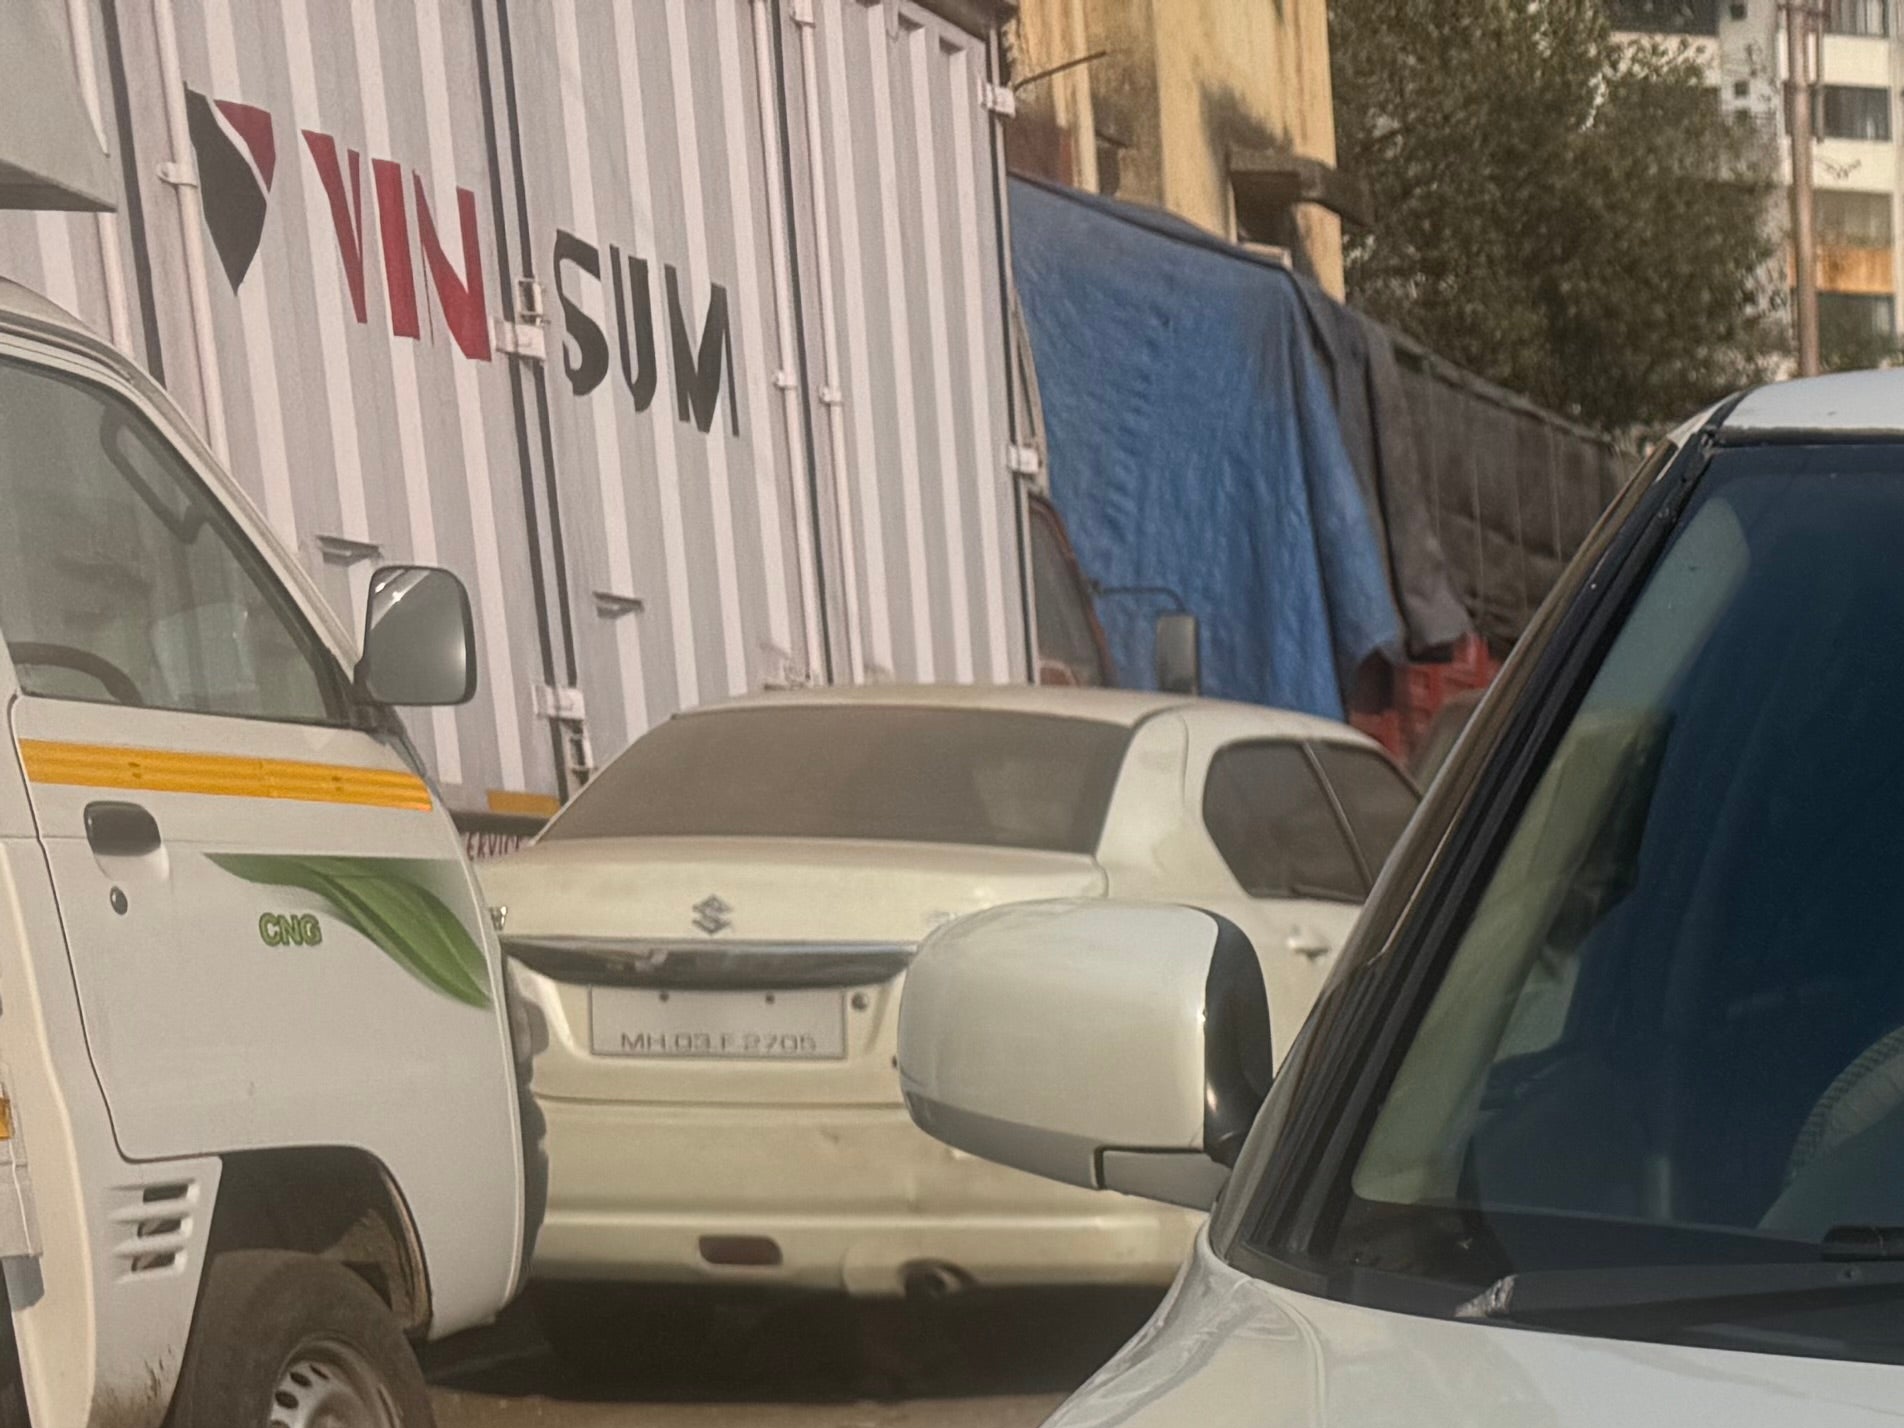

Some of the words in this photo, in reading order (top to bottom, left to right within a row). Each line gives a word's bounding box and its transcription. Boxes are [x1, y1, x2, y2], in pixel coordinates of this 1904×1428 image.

[301, 128, 492, 362] VIN
[554, 228, 740, 438] SUM
[259, 912, 323, 947] CNG
[621, 1032, 666, 1050] MH
